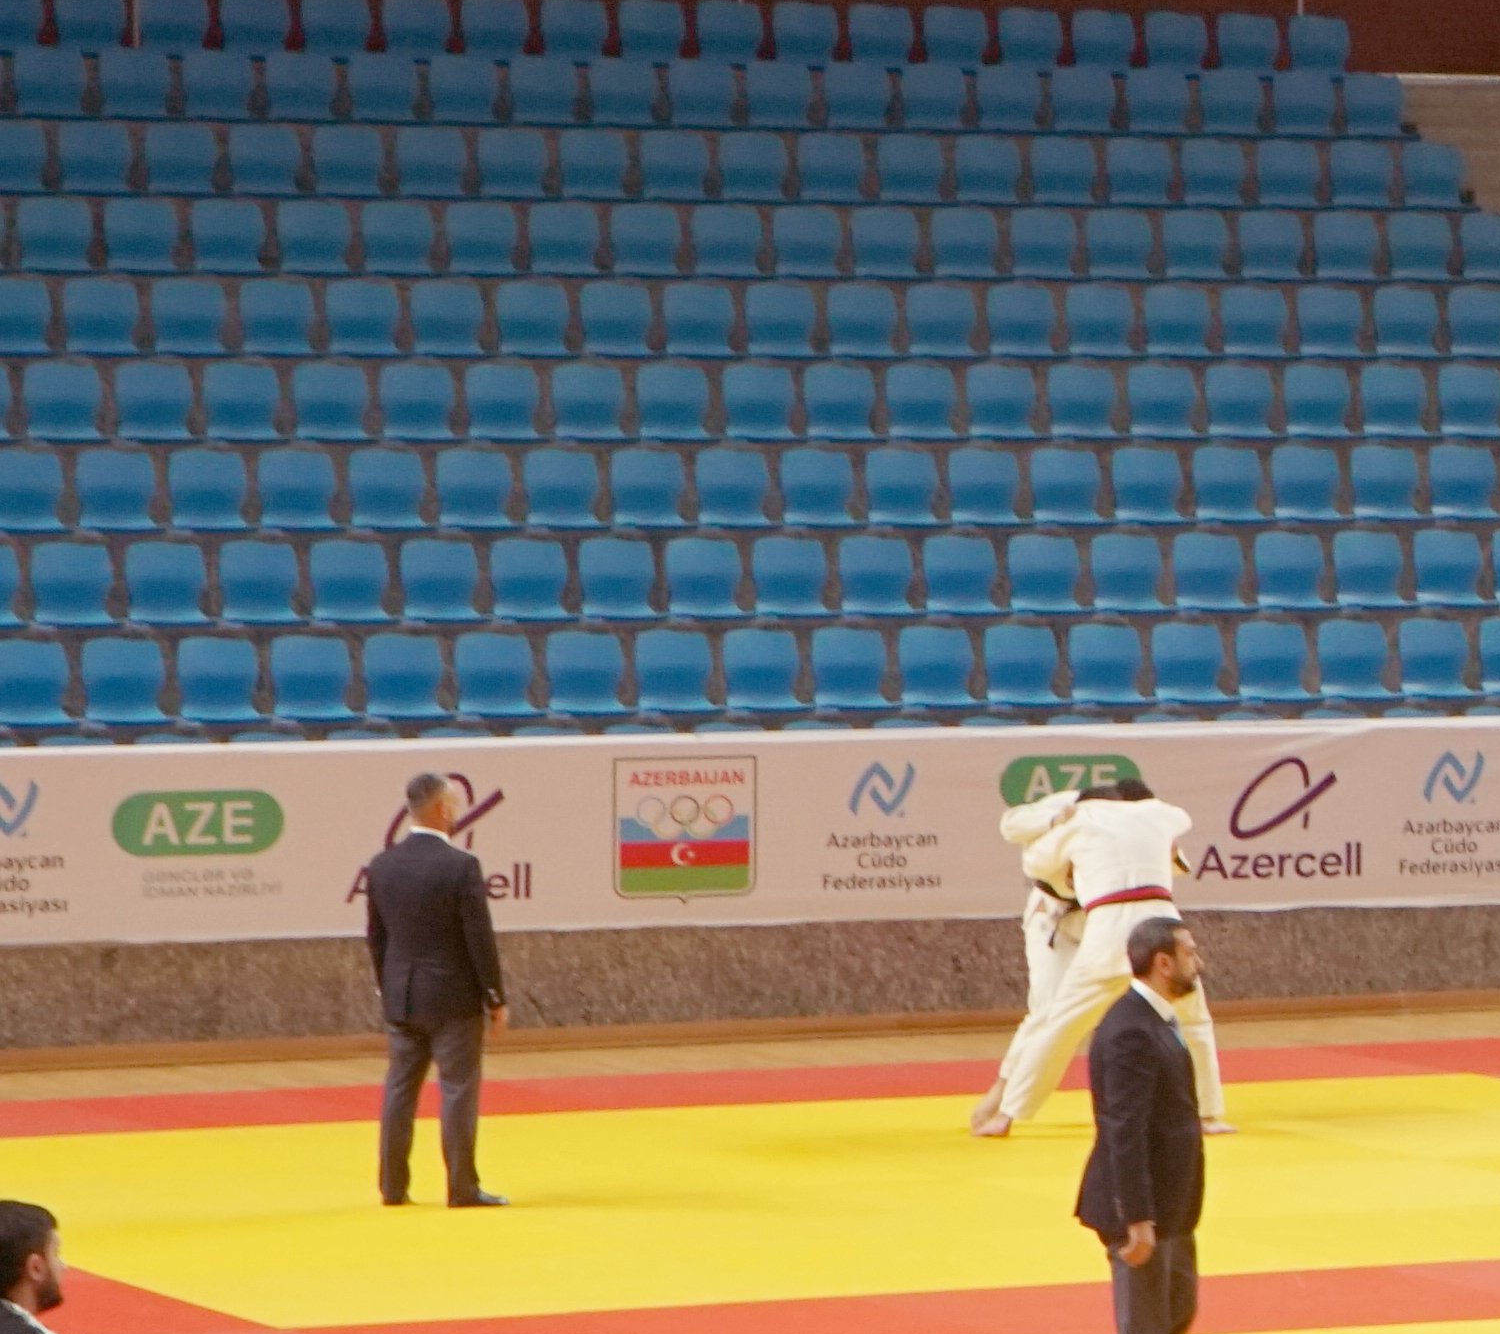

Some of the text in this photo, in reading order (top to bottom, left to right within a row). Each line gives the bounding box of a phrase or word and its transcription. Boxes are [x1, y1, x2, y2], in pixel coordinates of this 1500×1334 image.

[630, 770, 745, 788] AZERBAIJAN
[142, 802, 254, 846] AZE
[1195, 844, 1362, 880] Azercell
[345, 863, 532, 903] Aell
